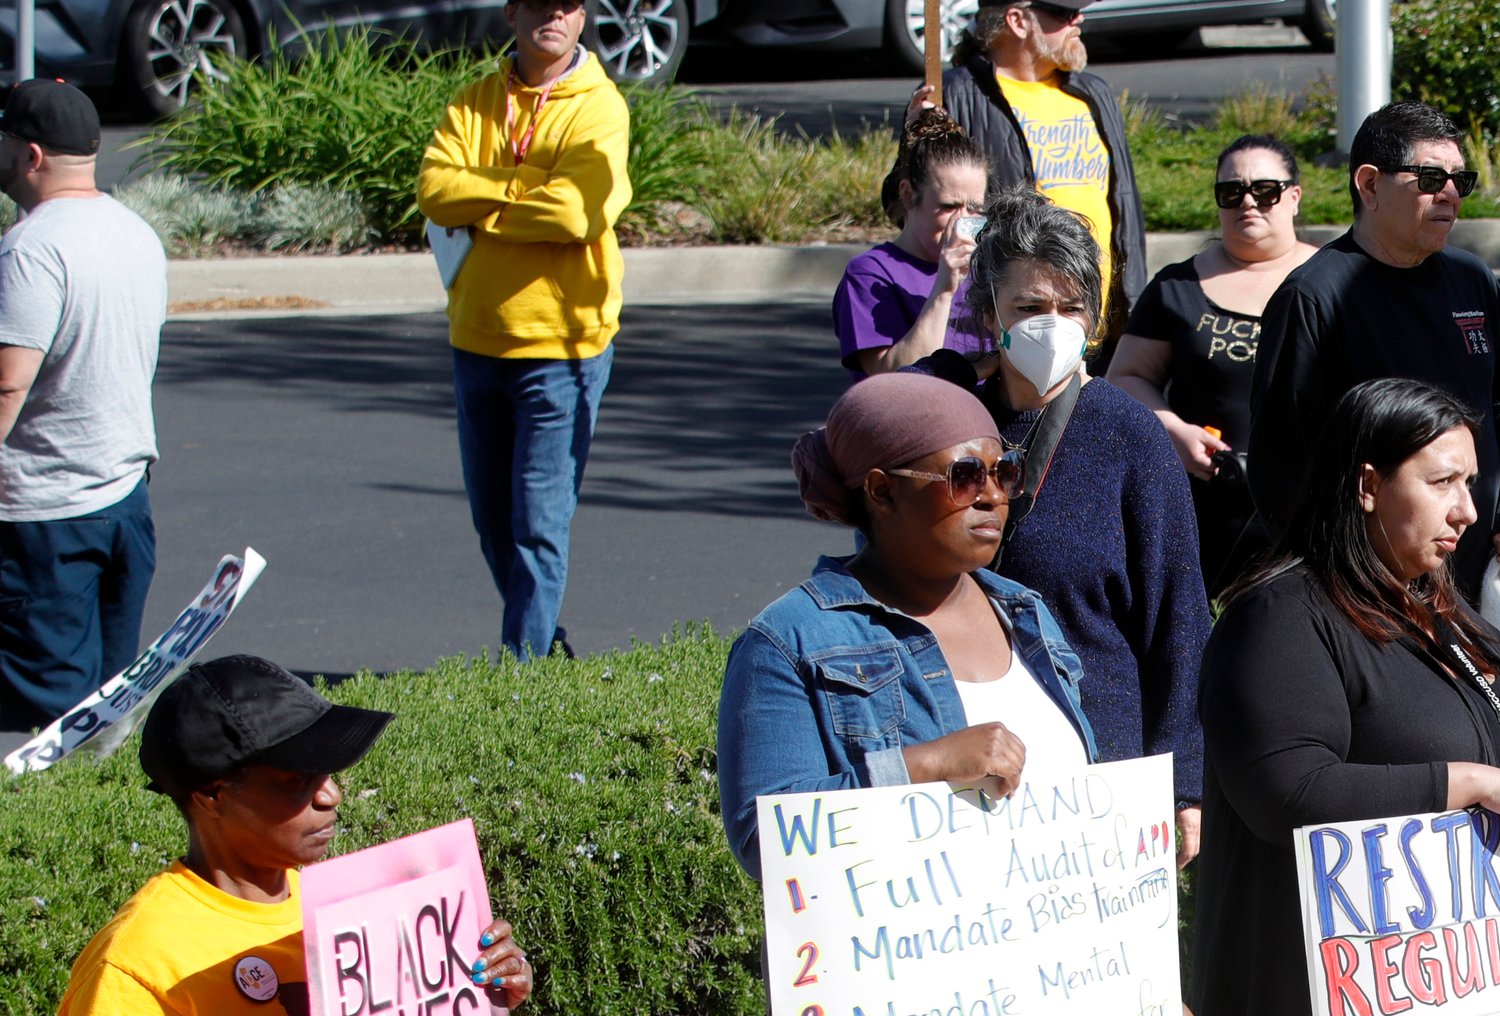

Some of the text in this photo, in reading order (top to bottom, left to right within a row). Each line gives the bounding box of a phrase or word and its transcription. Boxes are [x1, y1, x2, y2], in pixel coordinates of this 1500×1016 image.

[1450, 643, 1478, 676] Volunteer
[773, 773, 1113, 857] WE DEMAND
[843, 850, 964, 918] Full
[1004, 831, 1096, 888] Audit
[1102, 813, 1127, 870] of
[850, 902, 1020, 982] Mandate
[1026, 883, 1087, 933] Bias
[1038, 941, 1132, 1001] Mental
